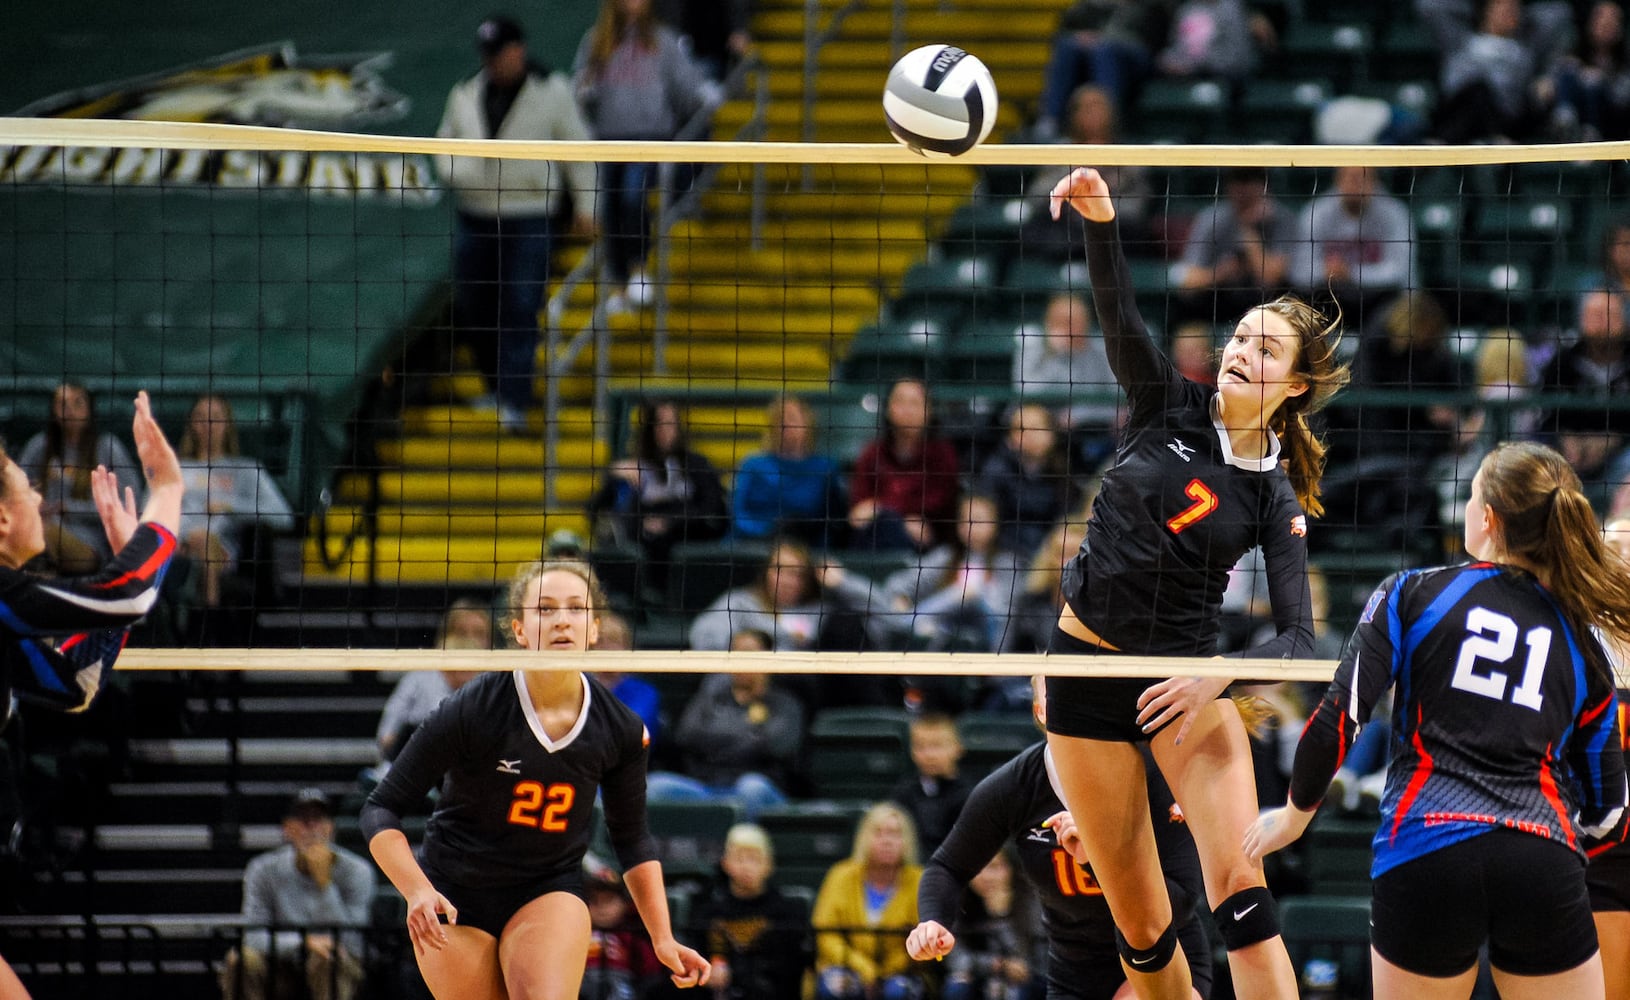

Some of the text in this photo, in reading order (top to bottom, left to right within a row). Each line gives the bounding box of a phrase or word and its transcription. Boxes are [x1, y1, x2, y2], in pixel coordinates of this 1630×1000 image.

[1166, 478, 1219, 535] 7
[1451, 606, 1553, 713] 21
[507, 779, 576, 833] 22
